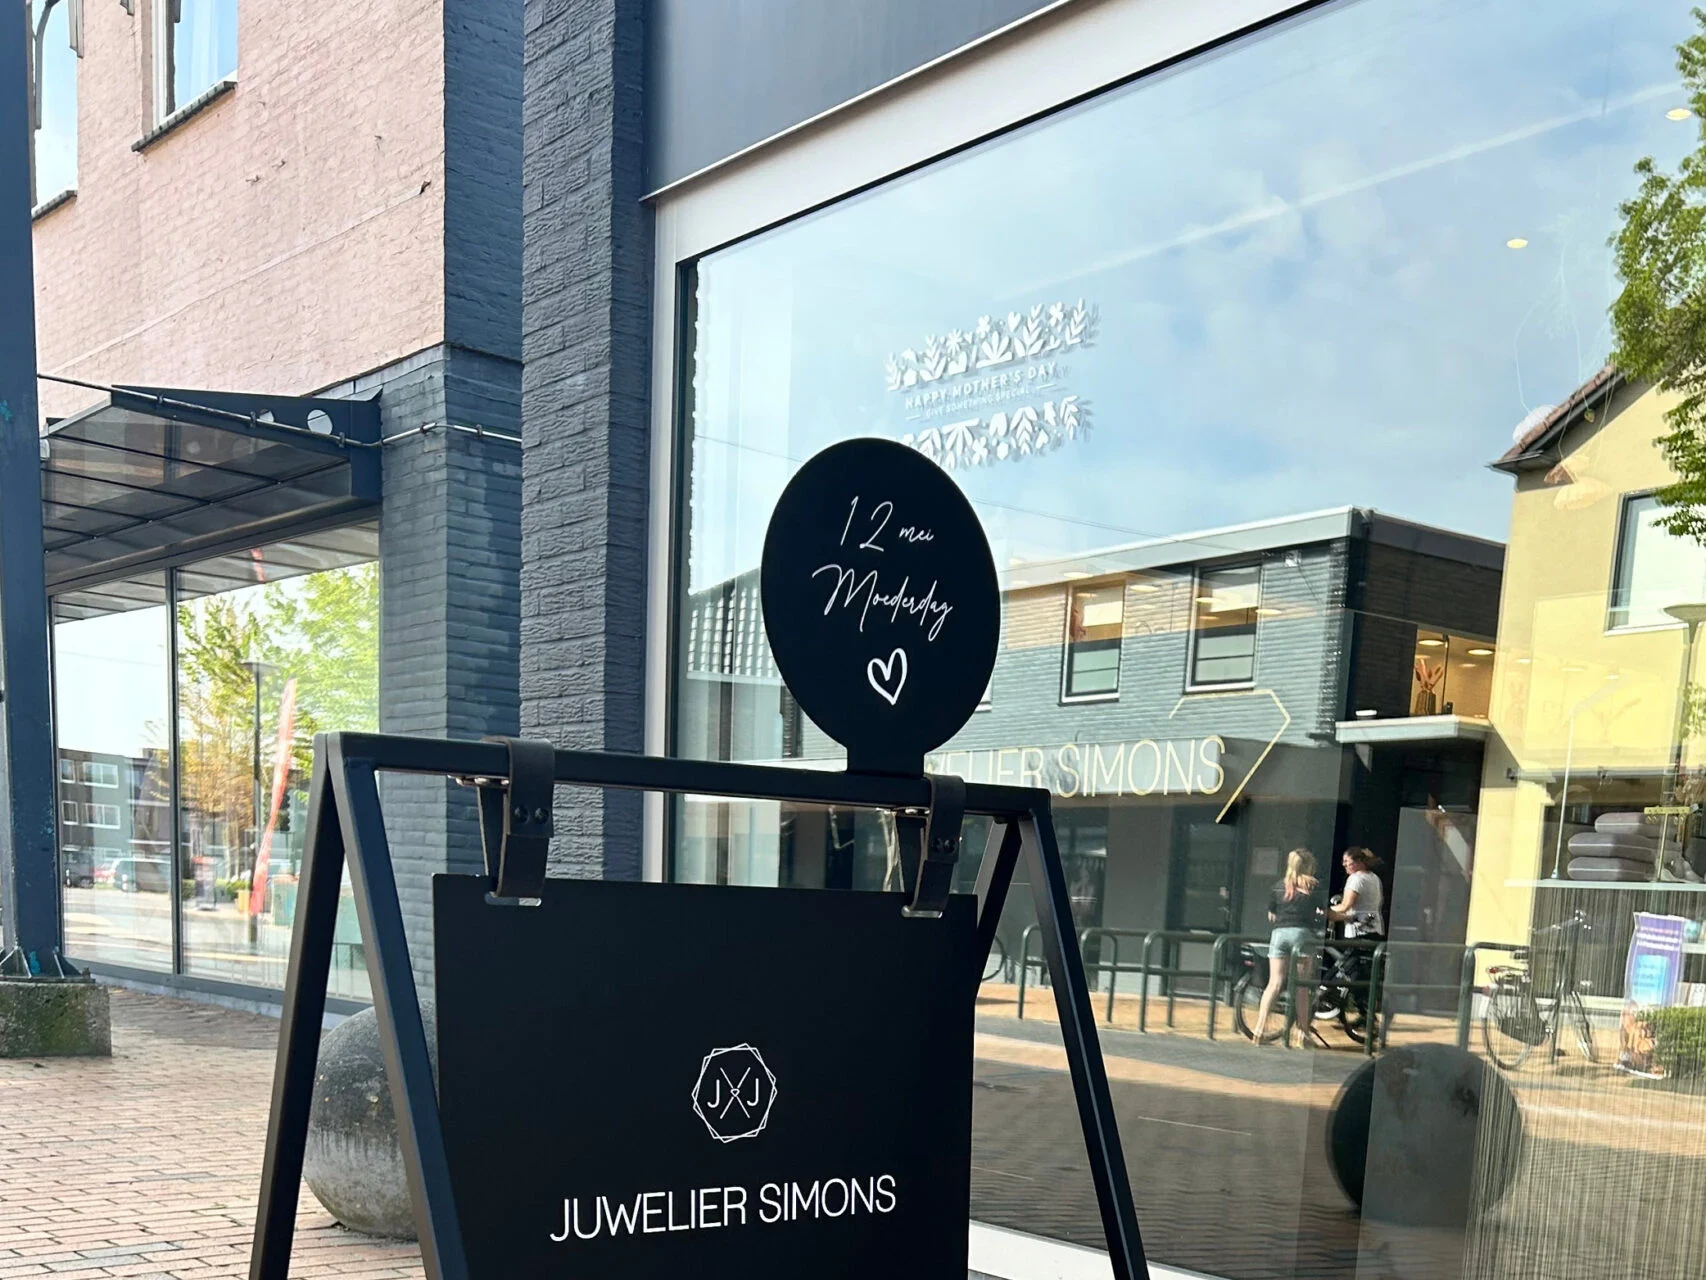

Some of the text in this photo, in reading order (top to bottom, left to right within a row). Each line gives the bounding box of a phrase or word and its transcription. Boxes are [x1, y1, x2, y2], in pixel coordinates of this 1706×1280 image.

[905, 361, 1056, 409] HAPPY MOTHER'S DAY
[899, 526, 935, 543] mei
[812, 563, 953, 642] Moederdag
[1055, 734, 1226, 798] SIMONS
[550, 1174, 896, 1242] JUWELIER SIMONS
